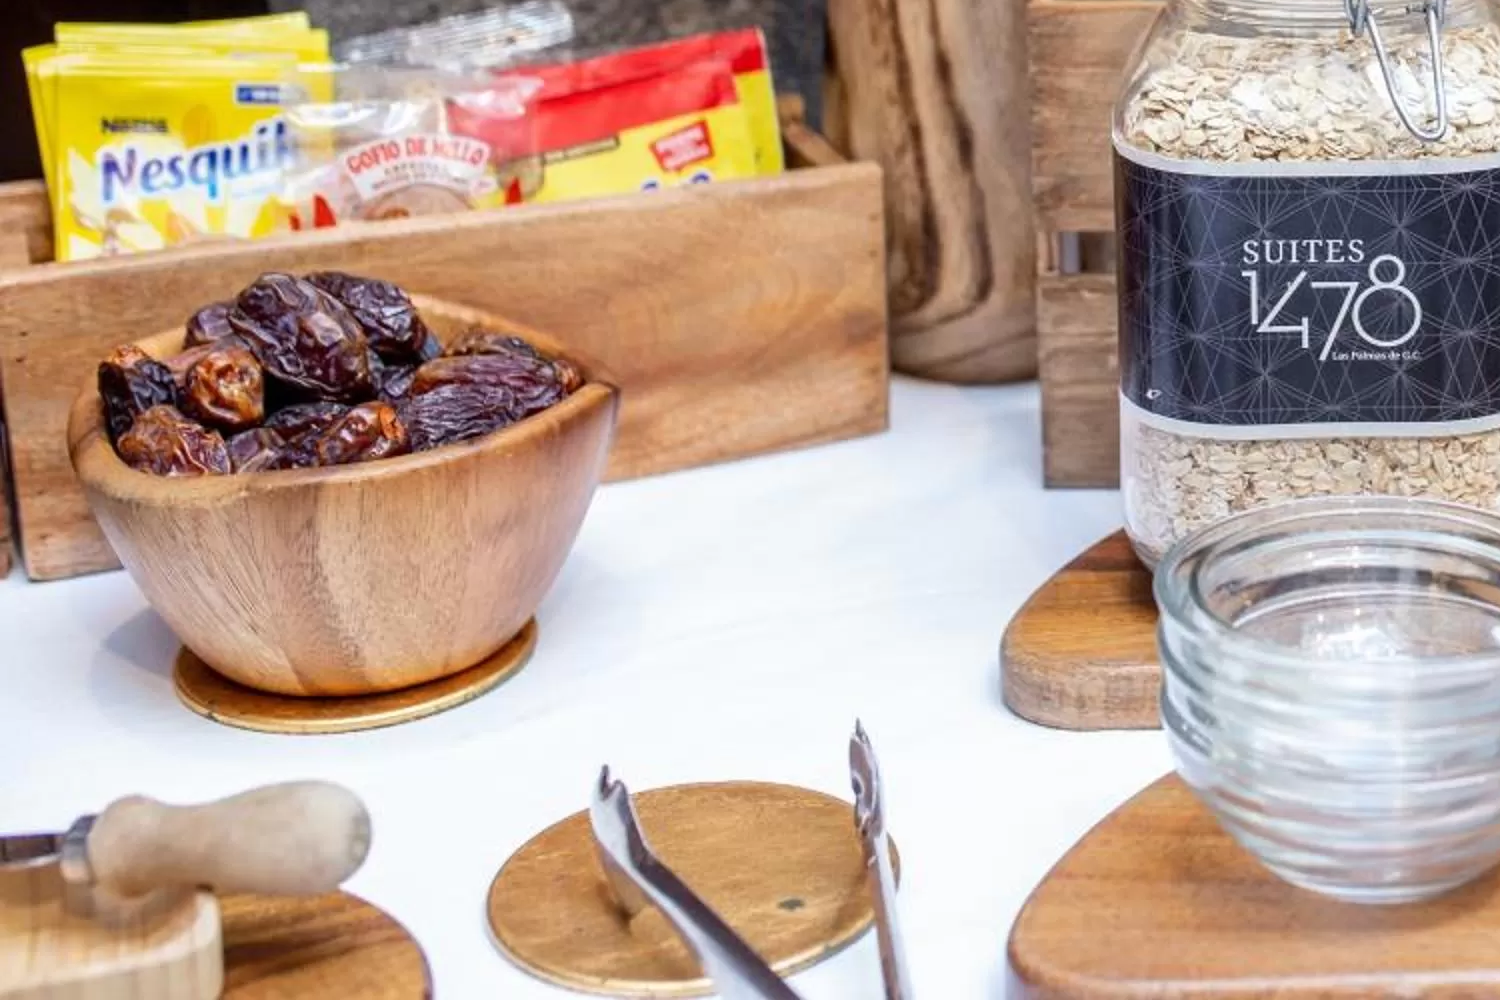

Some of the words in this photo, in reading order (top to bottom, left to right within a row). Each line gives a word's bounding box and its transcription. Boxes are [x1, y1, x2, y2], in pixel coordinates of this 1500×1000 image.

[1242, 239, 1365, 264] SUITES
[1241, 253, 1422, 361] 1478
[1332, 350, 1349, 361] Las
[1351, 350, 1387, 361] Palmas
[1388, 350, 1401, 361] de
